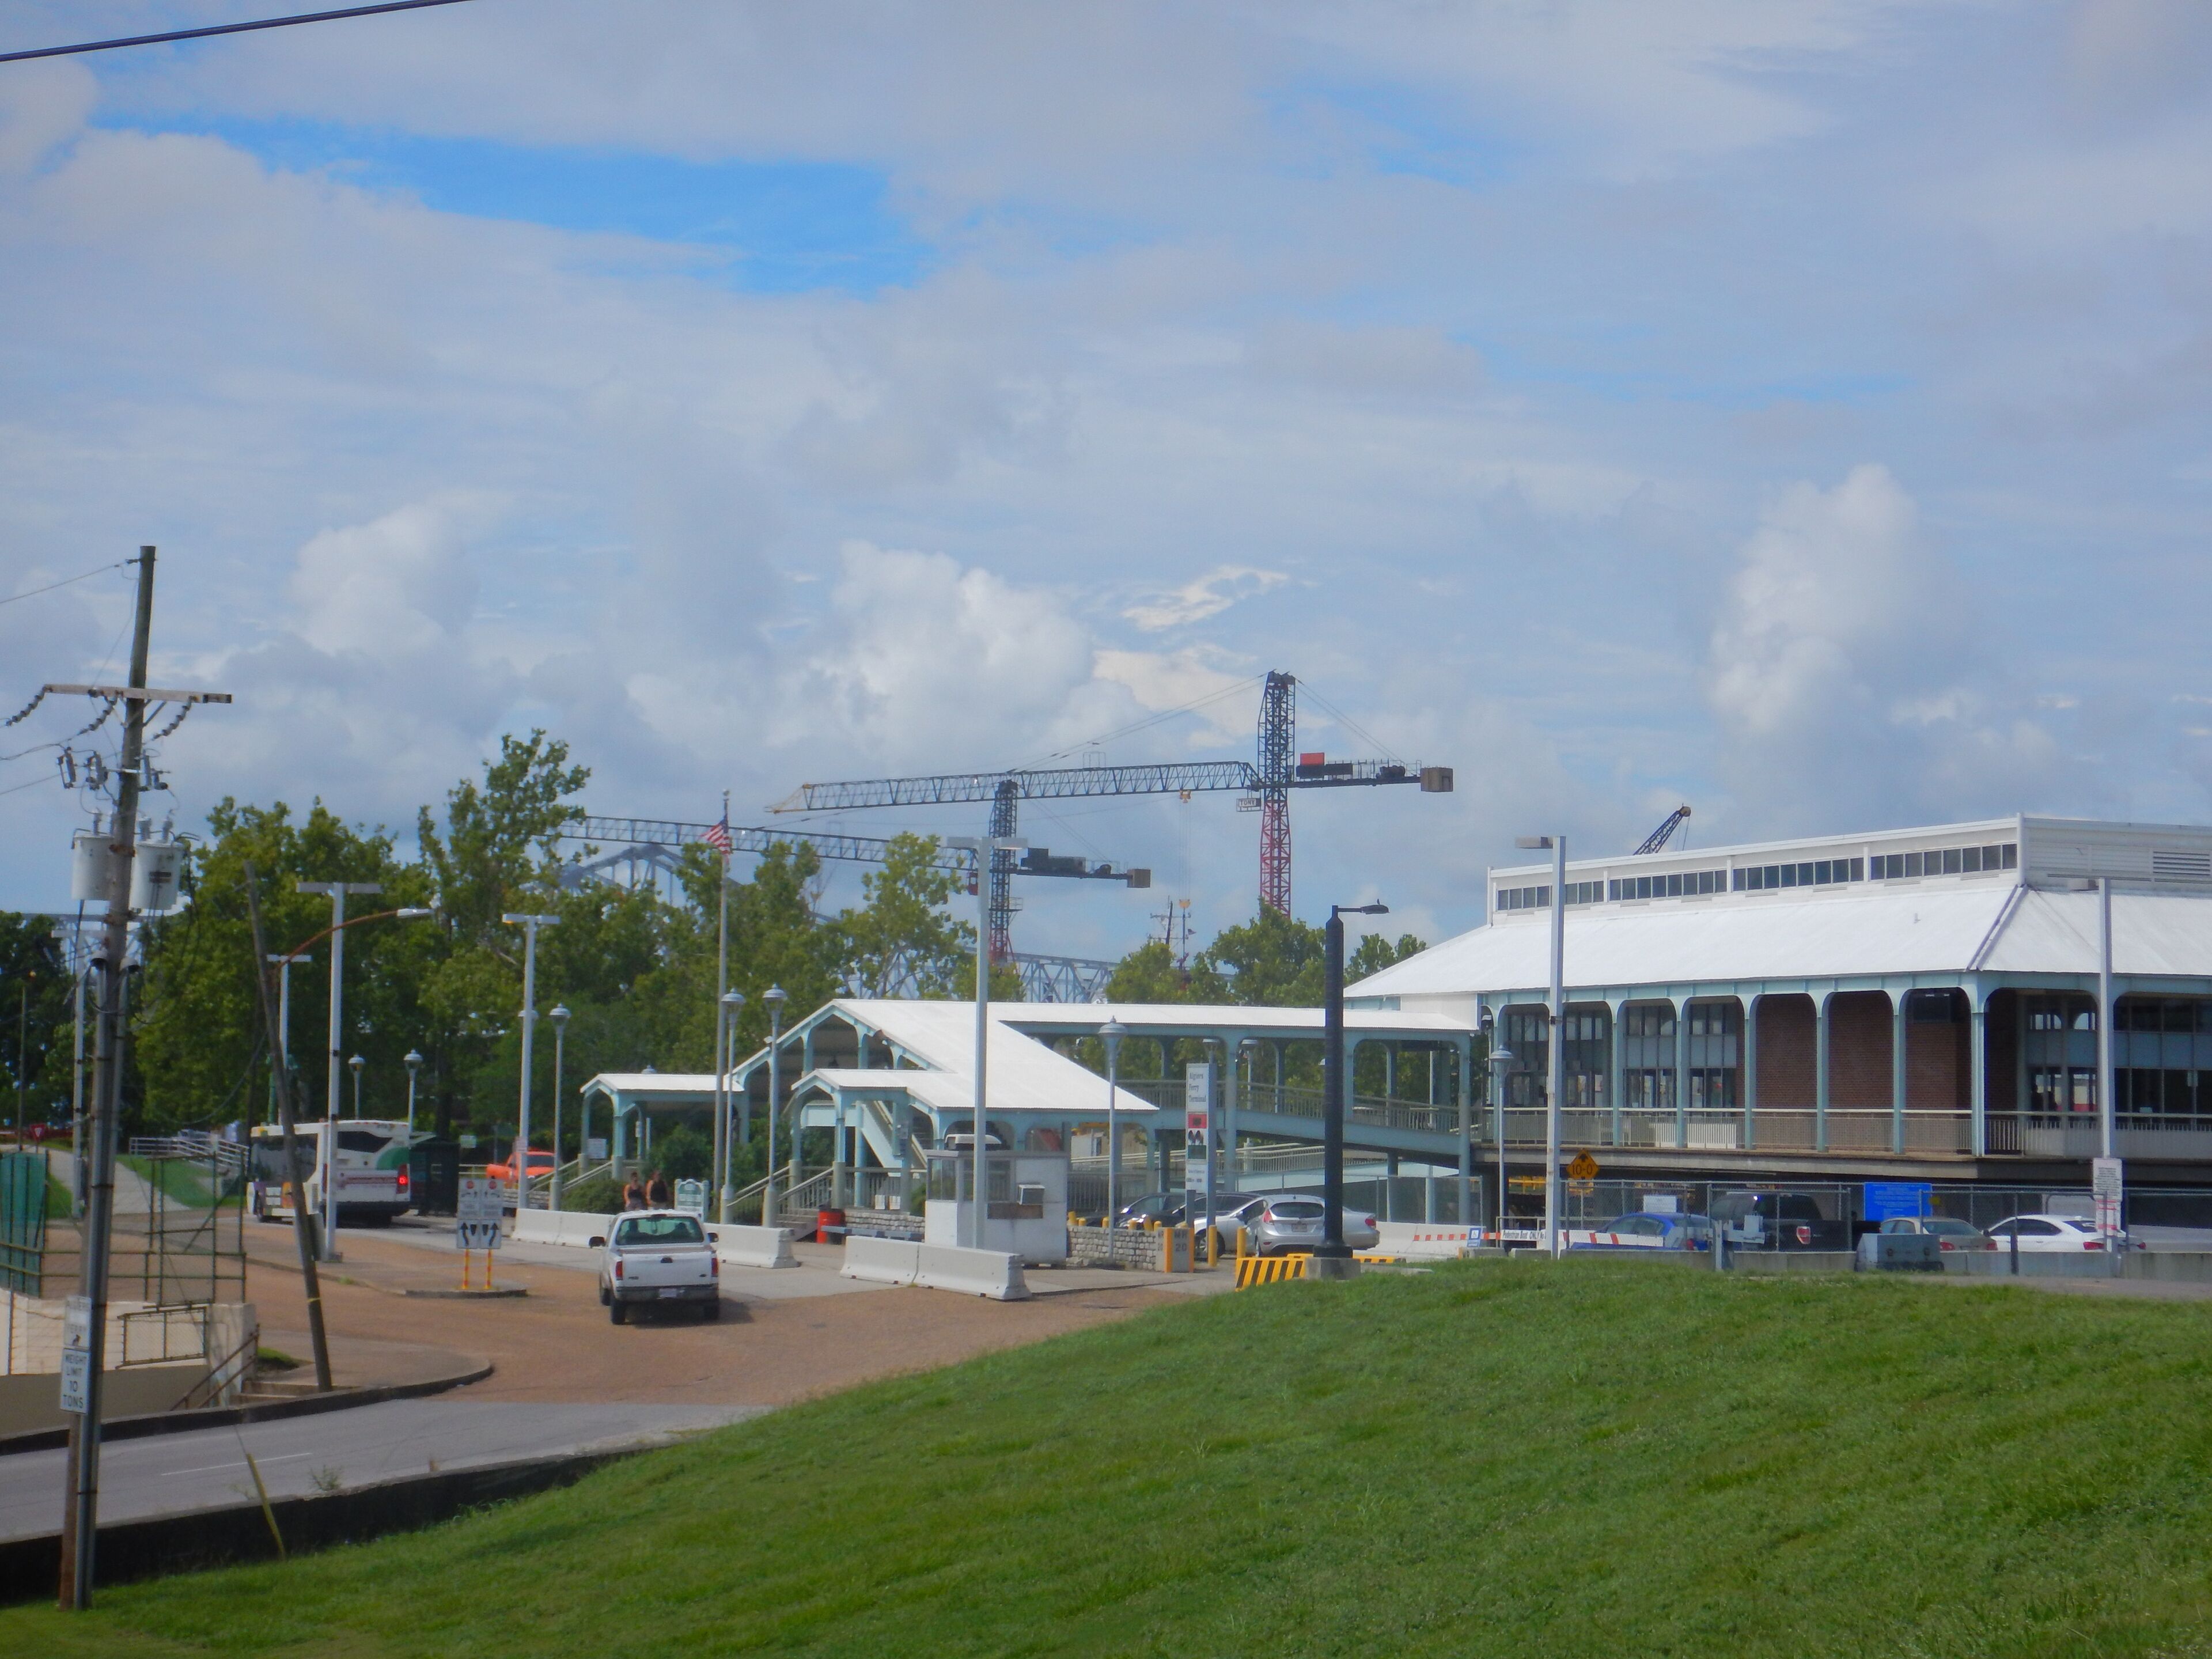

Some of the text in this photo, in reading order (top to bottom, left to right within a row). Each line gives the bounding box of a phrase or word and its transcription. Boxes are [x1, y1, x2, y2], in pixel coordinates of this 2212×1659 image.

[1189, 1084, 1199, 1092] Ferry
[1176, 1243, 1187, 1252] 20
[65, 1354, 87, 1365] WEIGHT
[67, 1366, 82, 1377] LIMIT
[70, 1380, 78, 1392] 10
[63, 1395, 84, 1408] TONS
